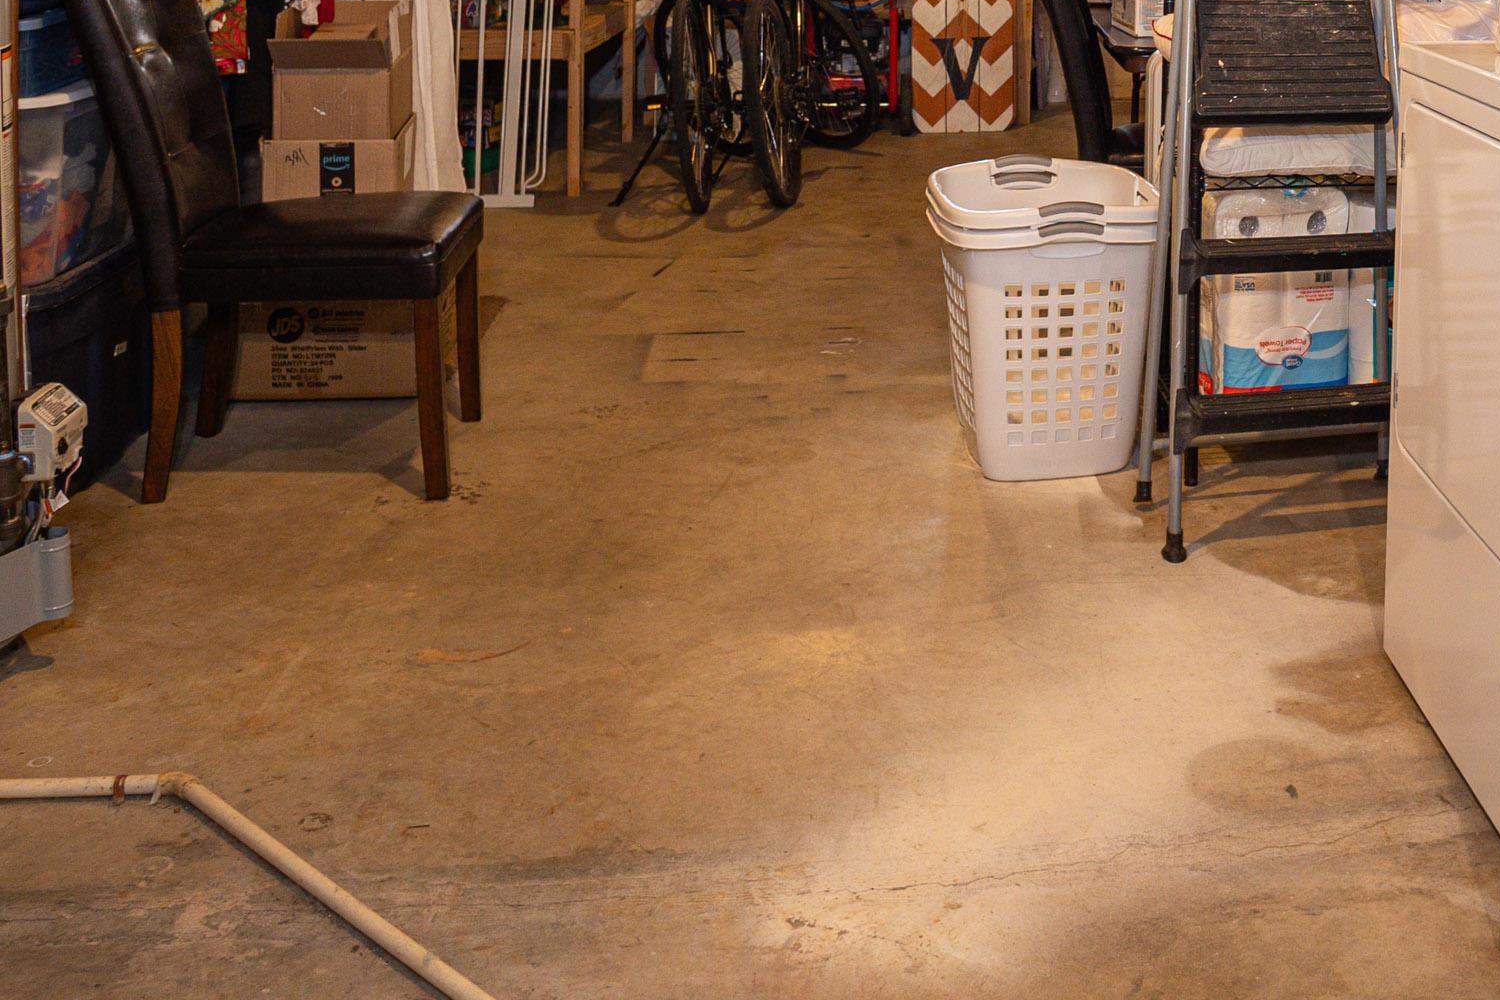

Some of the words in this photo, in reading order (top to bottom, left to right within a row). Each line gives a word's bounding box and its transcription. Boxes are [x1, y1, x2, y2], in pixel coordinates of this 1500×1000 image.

[929, 37, 992, 100] V
[323, 154, 351, 165] prime
[1259, 340, 1284, 348] Towels
[1285, 338, 1307, 347] Paper
